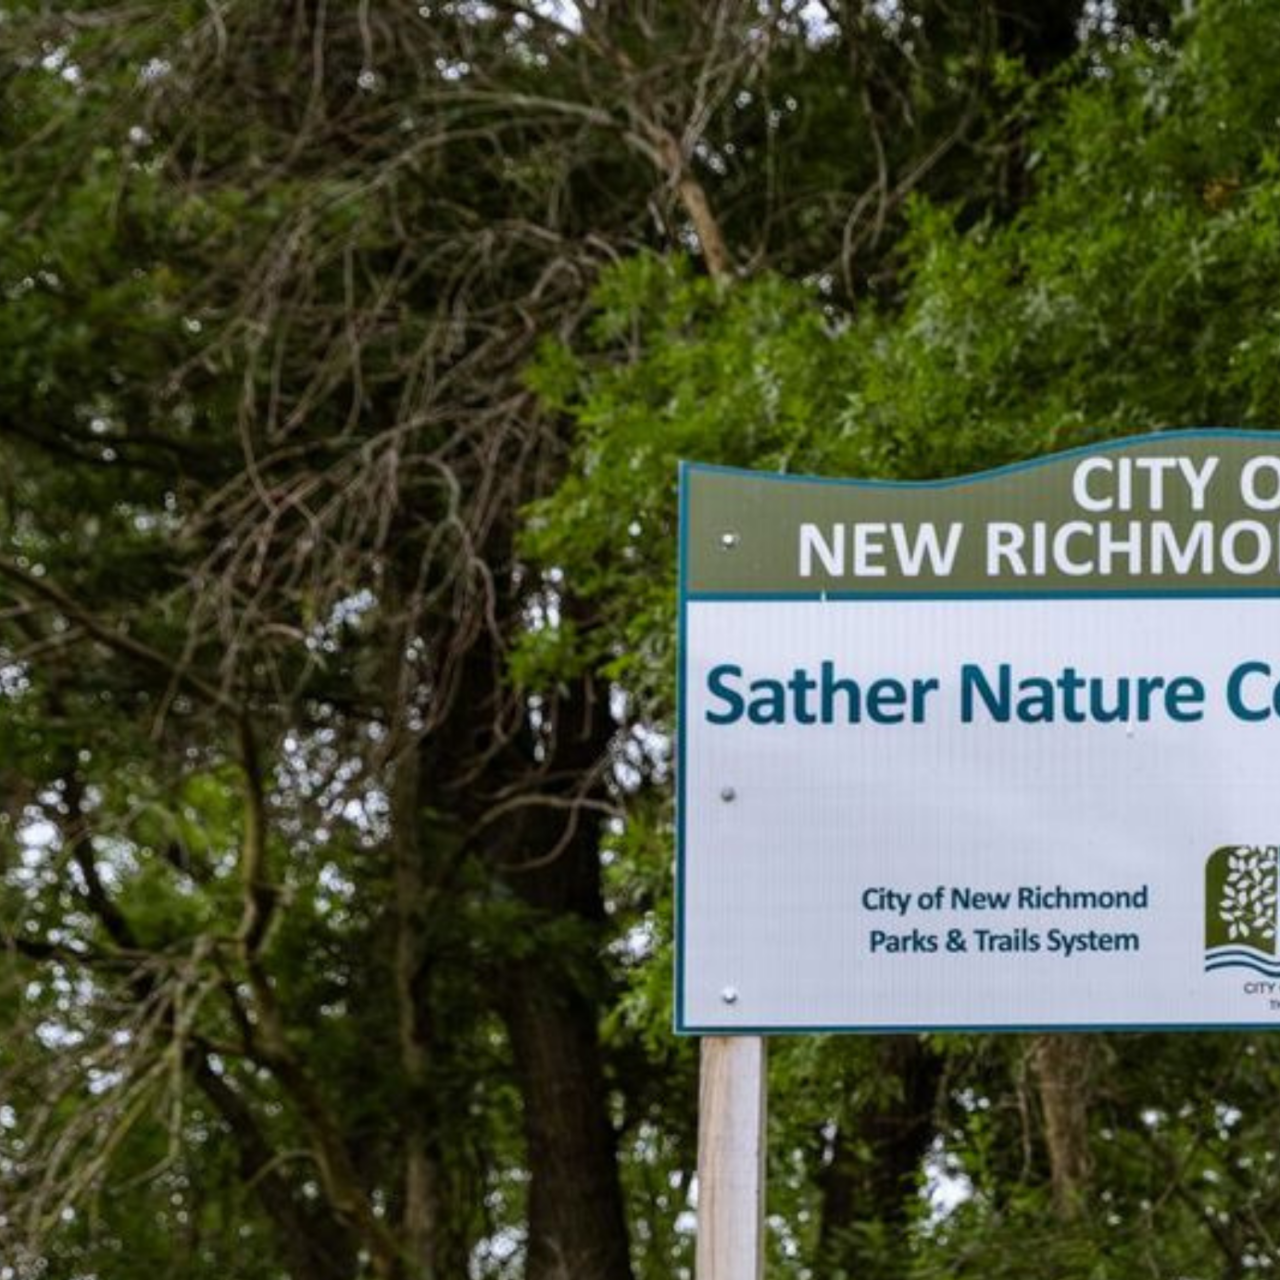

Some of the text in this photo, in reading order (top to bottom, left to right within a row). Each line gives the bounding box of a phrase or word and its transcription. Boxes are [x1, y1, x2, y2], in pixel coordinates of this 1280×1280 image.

[1072, 456, 1220, 512] CITY
[799, 522, 963, 577] NEW
[705, 660, 940, 726] Sather
[960, 663, 1205, 724] Nature
[861, 884, 1149, 916] City of New Richmond
[870, 927, 1140, 958] Parks & Trails System
[1243, 981, 1276, 995] CITY
